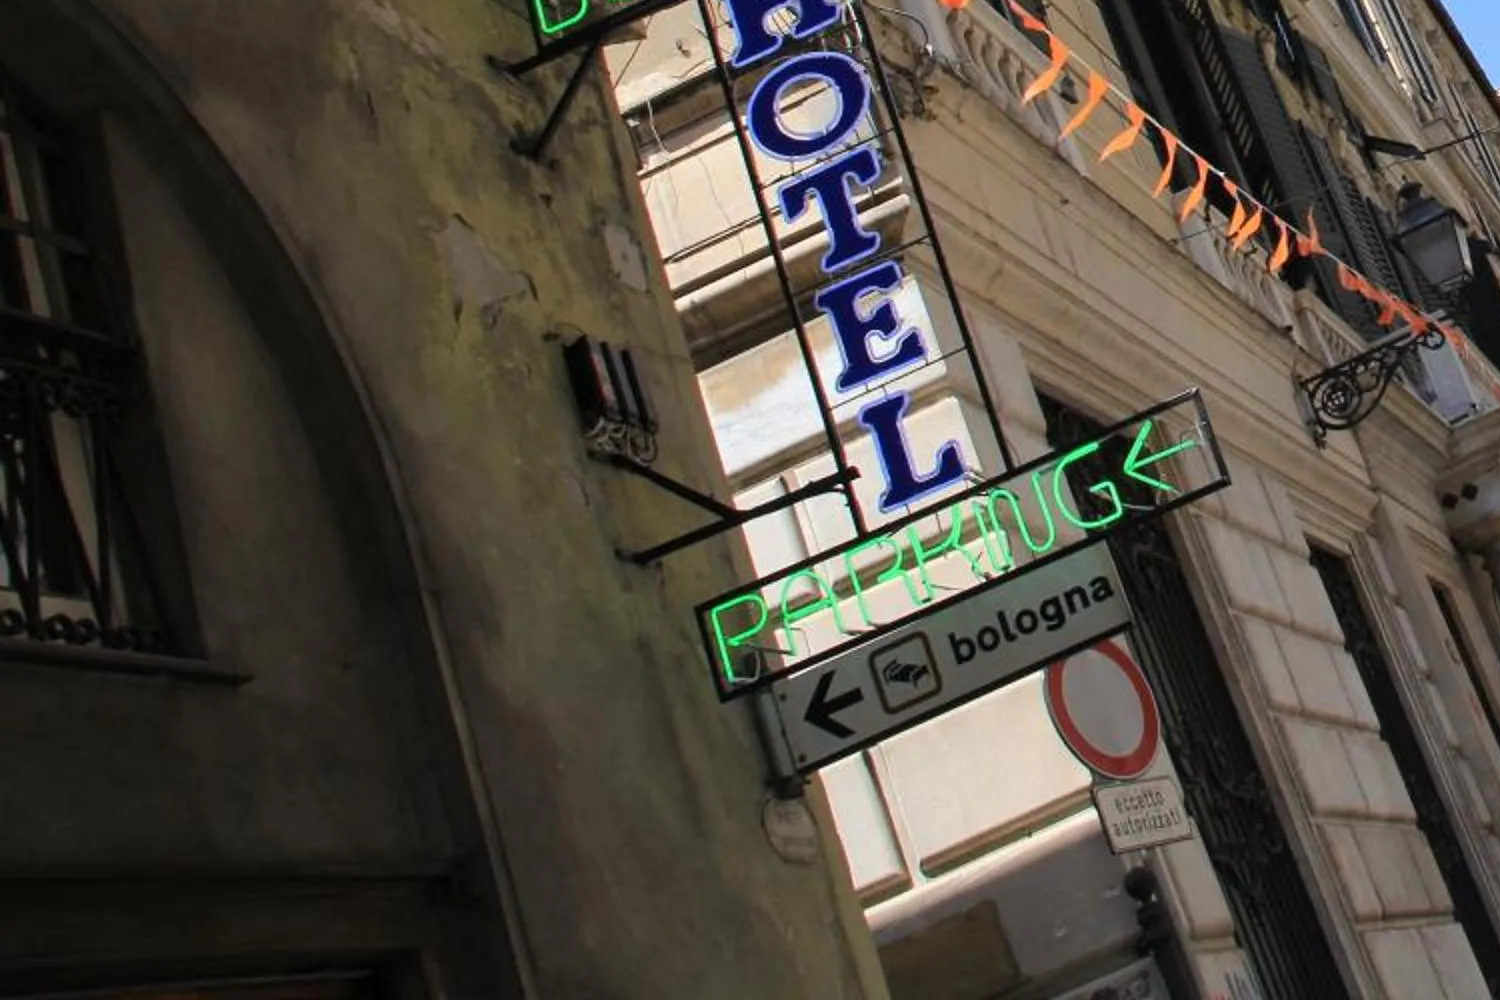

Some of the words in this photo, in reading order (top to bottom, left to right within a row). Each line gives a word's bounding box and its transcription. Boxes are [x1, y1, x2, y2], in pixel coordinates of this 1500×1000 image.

[709, 441, 1123, 684] PARKING
[949, 575, 1114, 665] bologna
[1112, 810, 1181, 837] autorizzati
[1114, 789, 1167, 814] eccetto
